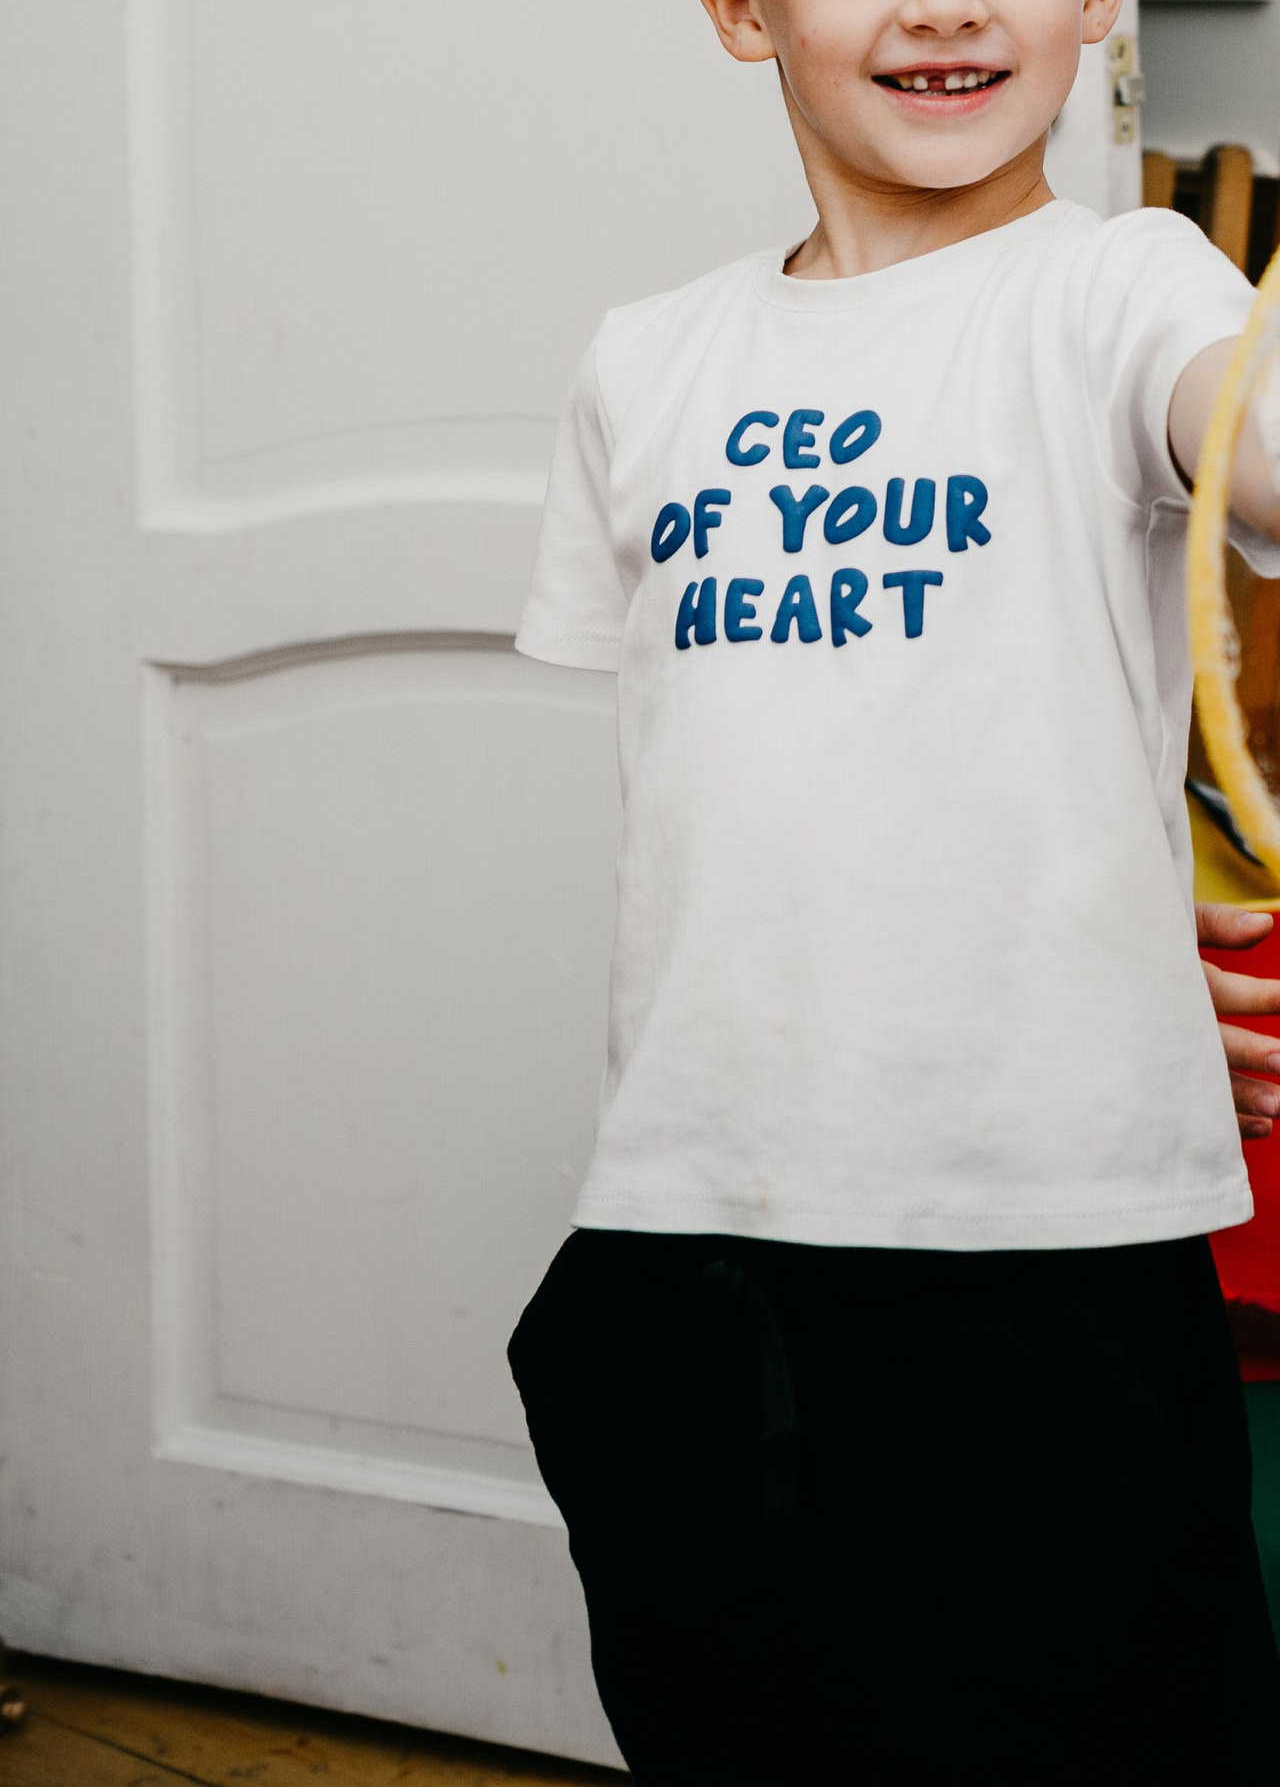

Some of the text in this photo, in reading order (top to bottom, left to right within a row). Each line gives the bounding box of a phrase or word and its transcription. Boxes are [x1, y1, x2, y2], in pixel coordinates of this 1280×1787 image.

[725, 409, 882, 469] CEO
[651, 475, 992, 564] OF YOUR
[675, 568, 943, 650] HEART
